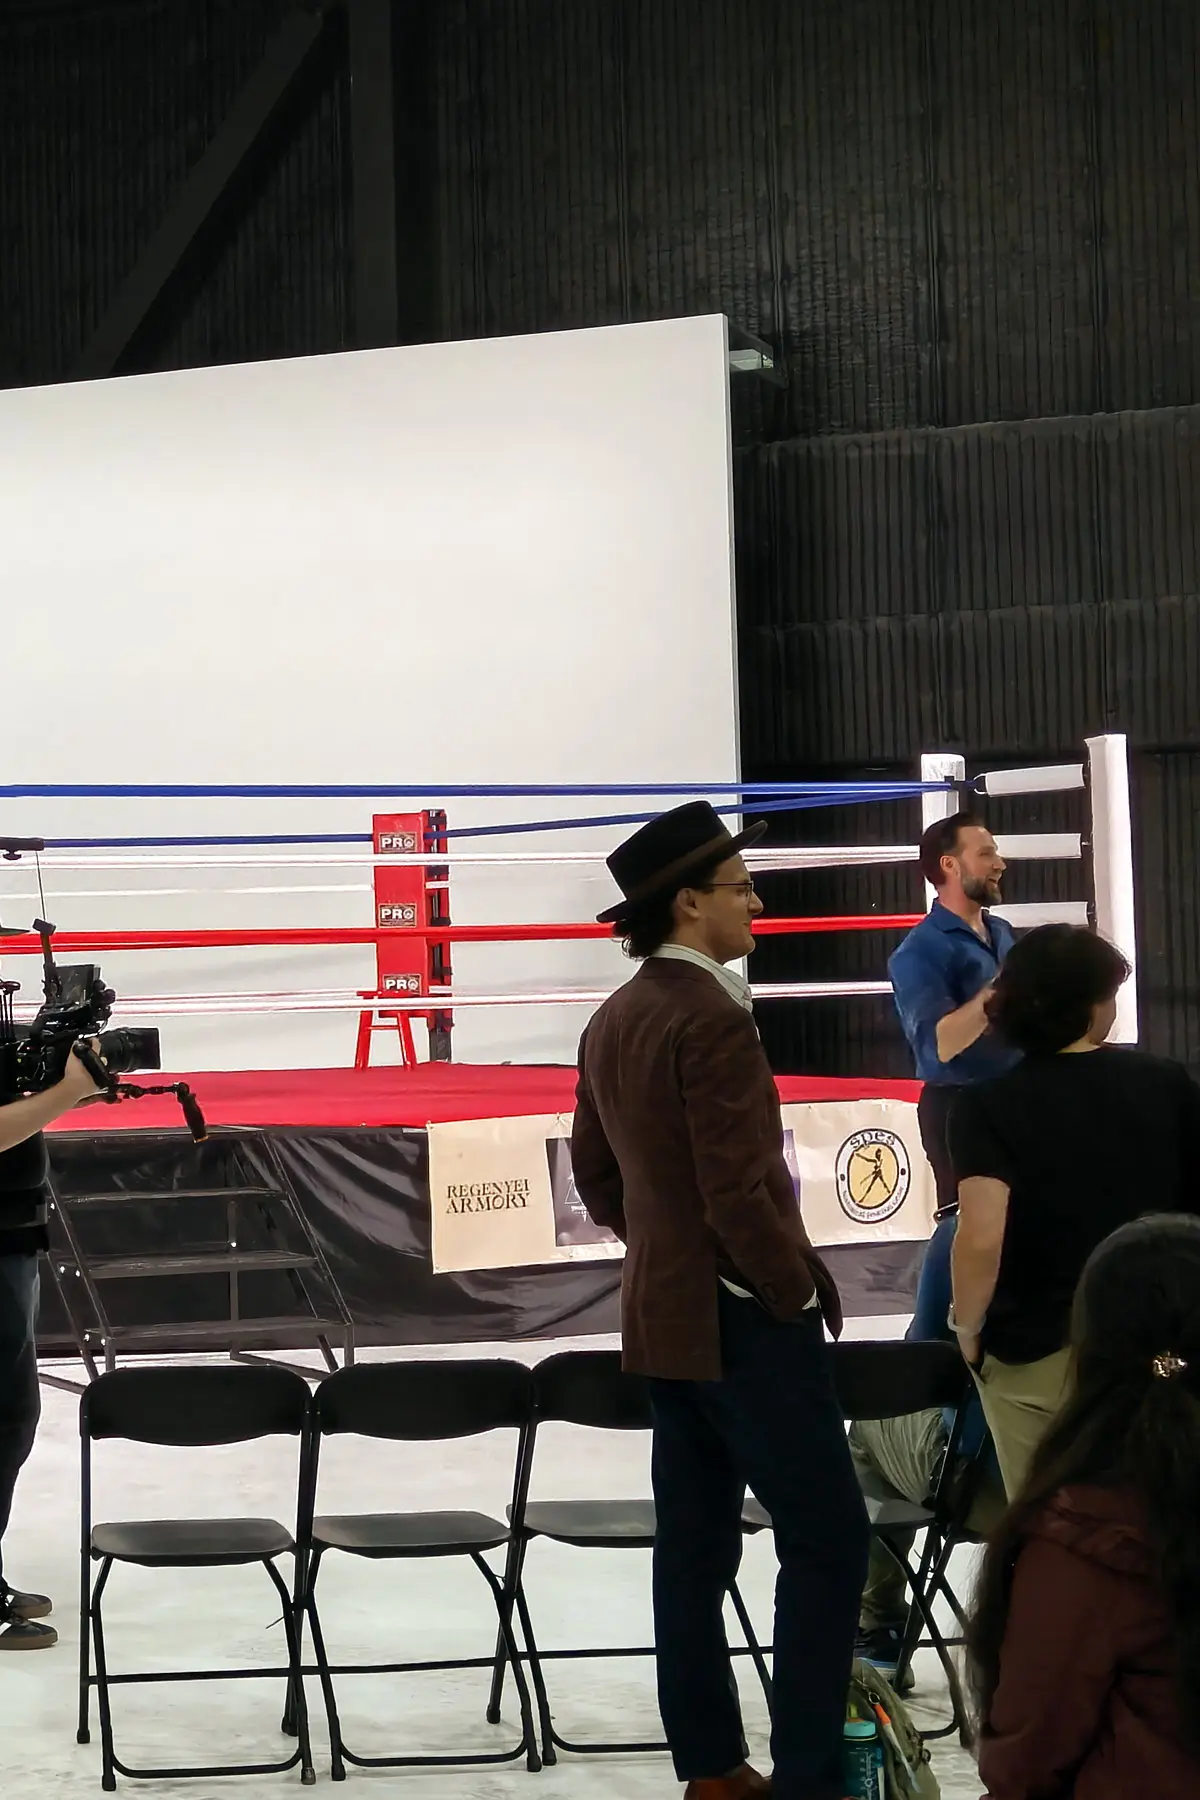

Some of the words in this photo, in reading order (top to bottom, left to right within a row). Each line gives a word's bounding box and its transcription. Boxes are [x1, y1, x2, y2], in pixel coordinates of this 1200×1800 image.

[381, 836, 414, 849] PRO
[381, 908, 414, 919] PRO
[385, 979, 418, 990] PRO
[447, 1179, 530, 1199] REGENYEI
[446, 1192, 531, 1214] ARMORY
